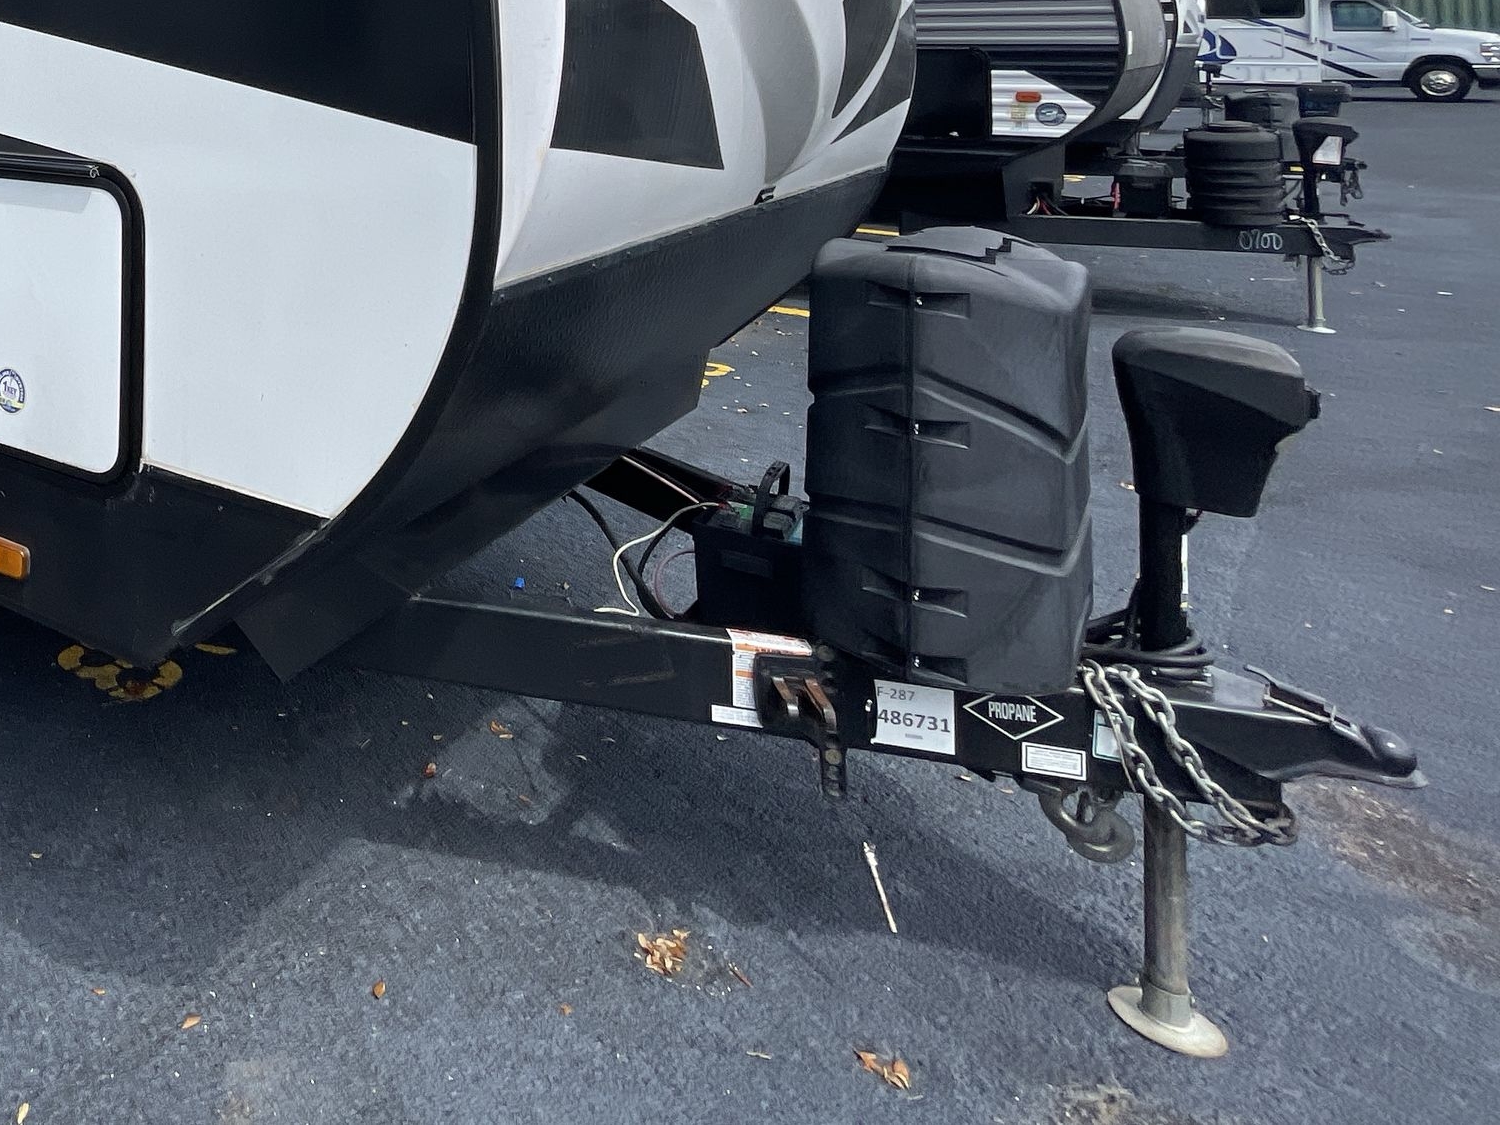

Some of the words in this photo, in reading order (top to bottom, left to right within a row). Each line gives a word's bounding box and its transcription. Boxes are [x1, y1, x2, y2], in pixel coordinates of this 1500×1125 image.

[877, 686, 915, 701] F-287
[878, 709, 951, 733] 486731
[988, 701, 1037, 723] PROPANE
